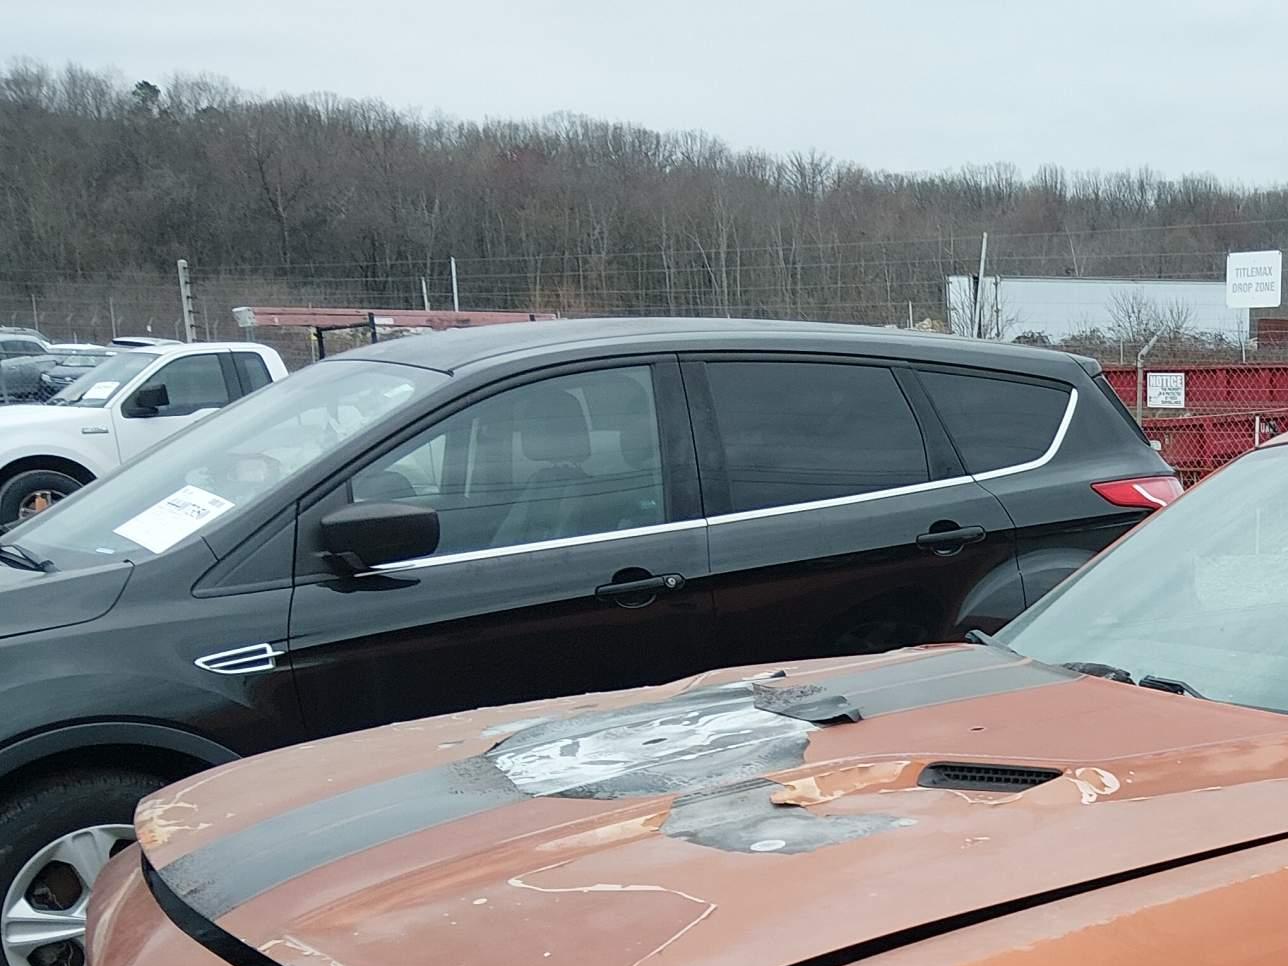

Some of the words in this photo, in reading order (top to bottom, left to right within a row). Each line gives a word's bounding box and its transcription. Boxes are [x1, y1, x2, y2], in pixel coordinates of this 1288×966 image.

[1235, 266, 1273, 278] TITLEMAX
[1232, 283, 1253, 293] DROP
[1255, 282, 1275, 292] ZONE
[1149, 375, 1184, 387] NOTICE
